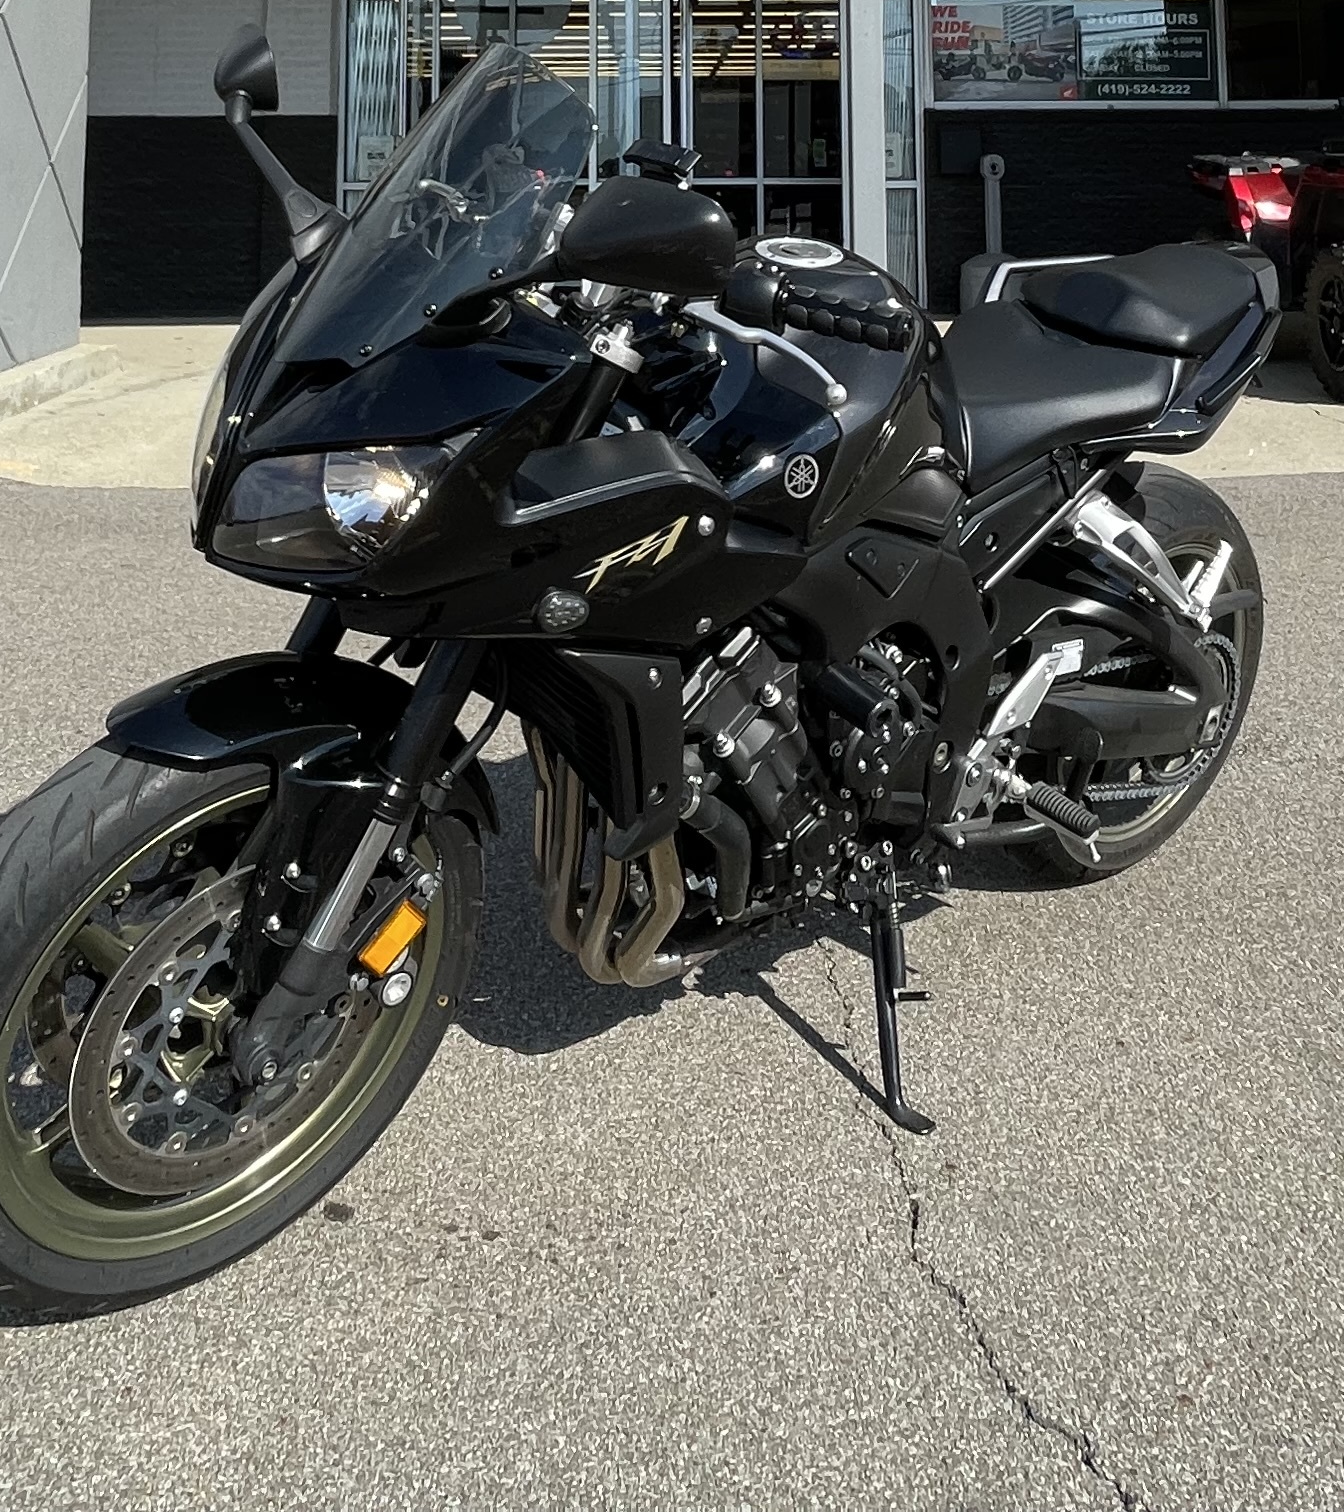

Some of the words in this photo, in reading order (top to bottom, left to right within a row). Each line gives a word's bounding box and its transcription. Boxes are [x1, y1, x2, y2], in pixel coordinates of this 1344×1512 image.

[1142, 13, 1199, 25] HOURS
[932, 21, 972, 34] RIDE
[1097, 84, 1191, 96] (419)-524-2222
